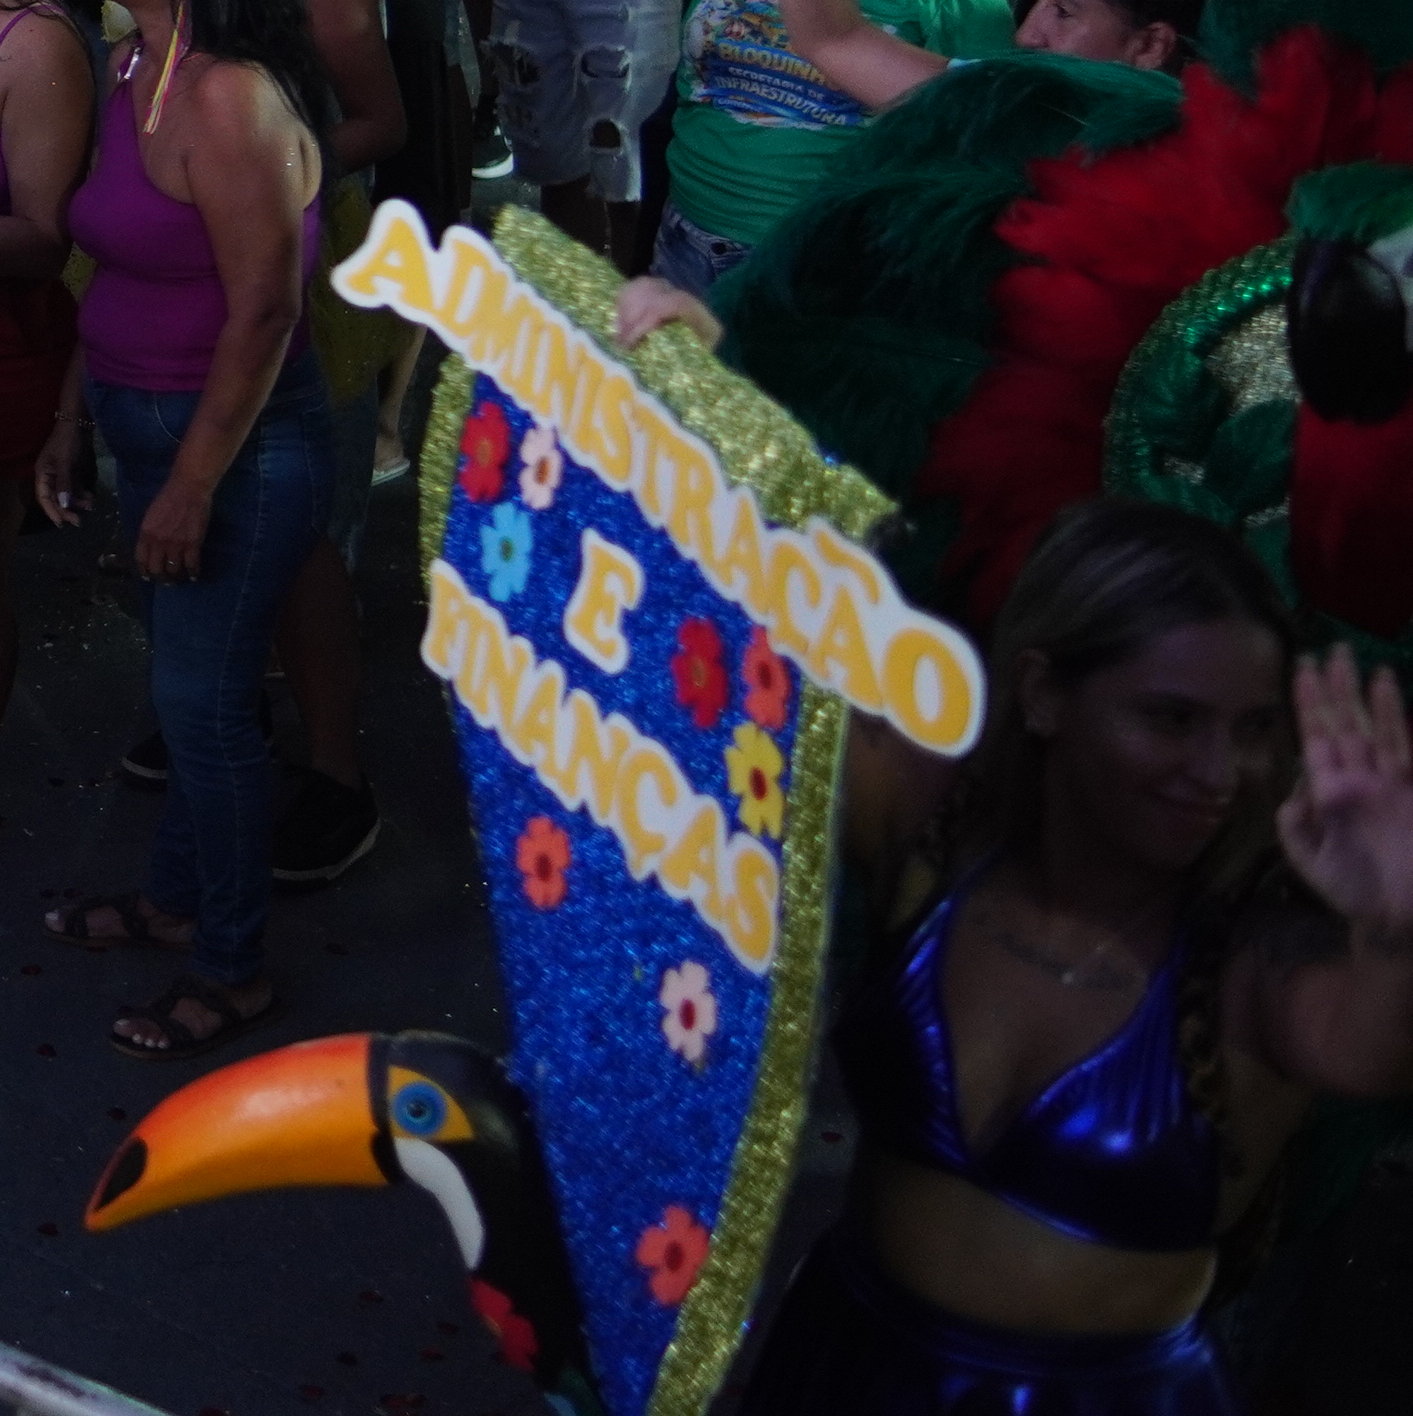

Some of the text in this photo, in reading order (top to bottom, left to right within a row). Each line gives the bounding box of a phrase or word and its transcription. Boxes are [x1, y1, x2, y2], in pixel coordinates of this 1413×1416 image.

[715, 76, 848, 126] INFRAESTRUTURA
[339, 211, 976, 750] ADMINISTRAÇÃO
[569, 542, 640, 669] E
[426, 571, 774, 971] FINANÇAS
